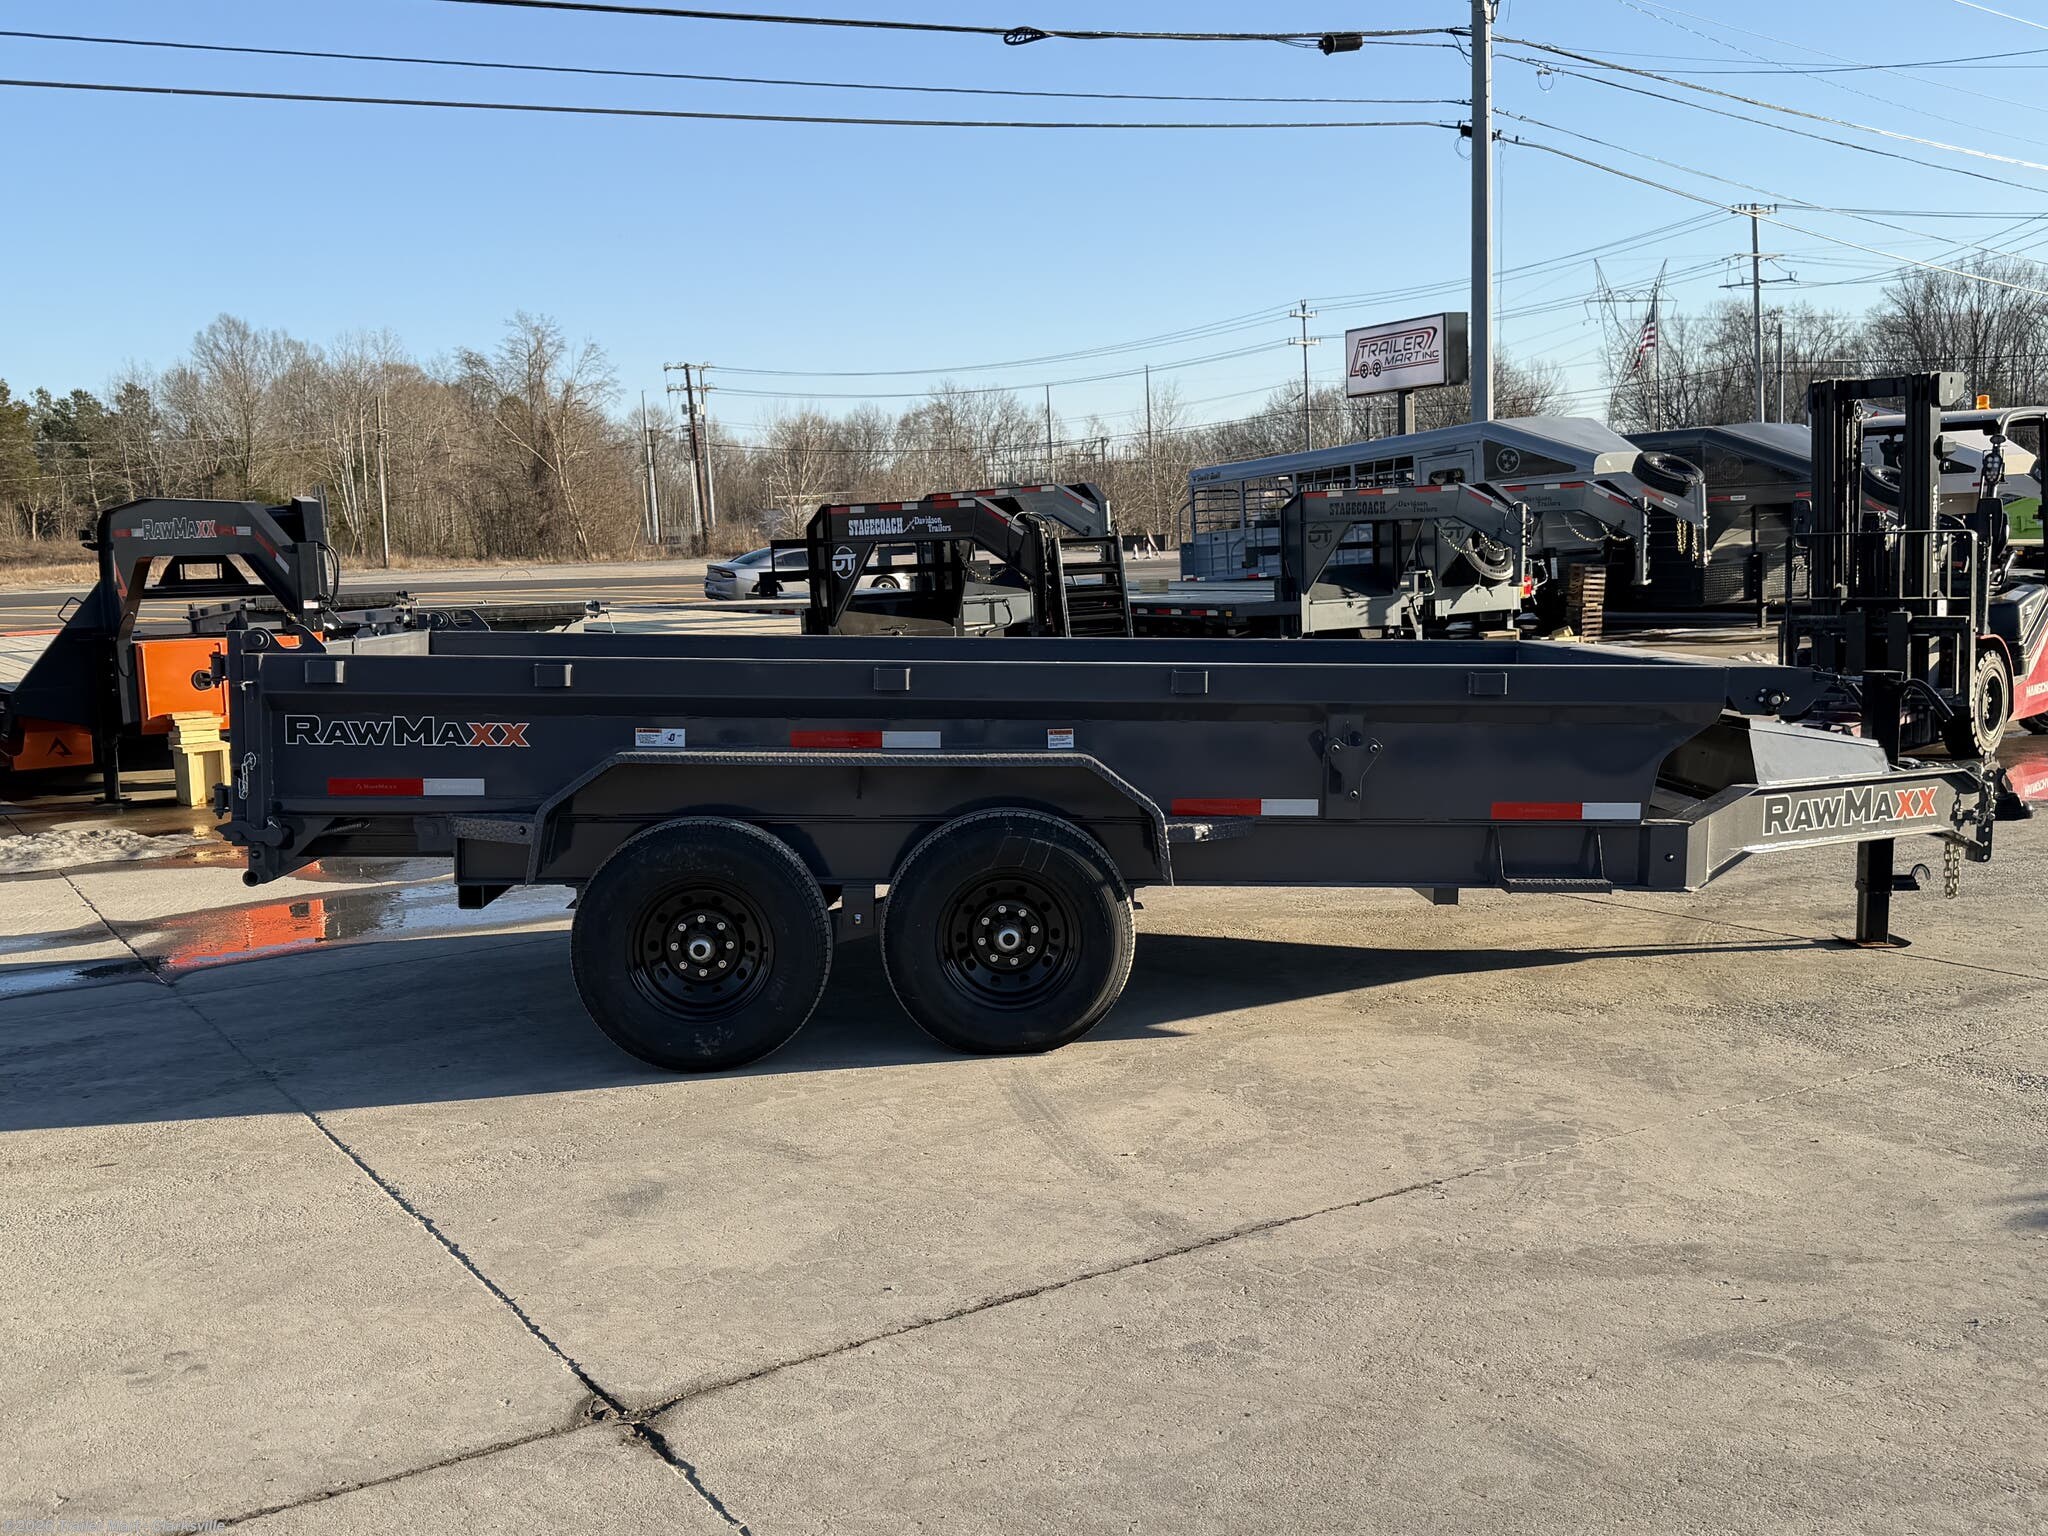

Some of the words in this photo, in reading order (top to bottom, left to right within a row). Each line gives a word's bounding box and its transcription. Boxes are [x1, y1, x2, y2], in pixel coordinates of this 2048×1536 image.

[1360, 334, 1425, 359] TRAILER
[1384, 351, 1421, 366] MART
[1422, 349, 1440, 359] INC
[1329, 501, 1386, 516] STAGECOACH
[848, 517, 904, 536] STAGECOACH
[914, 515, 942, 525] Davidson
[928, 524, 952, 533] Trailers
